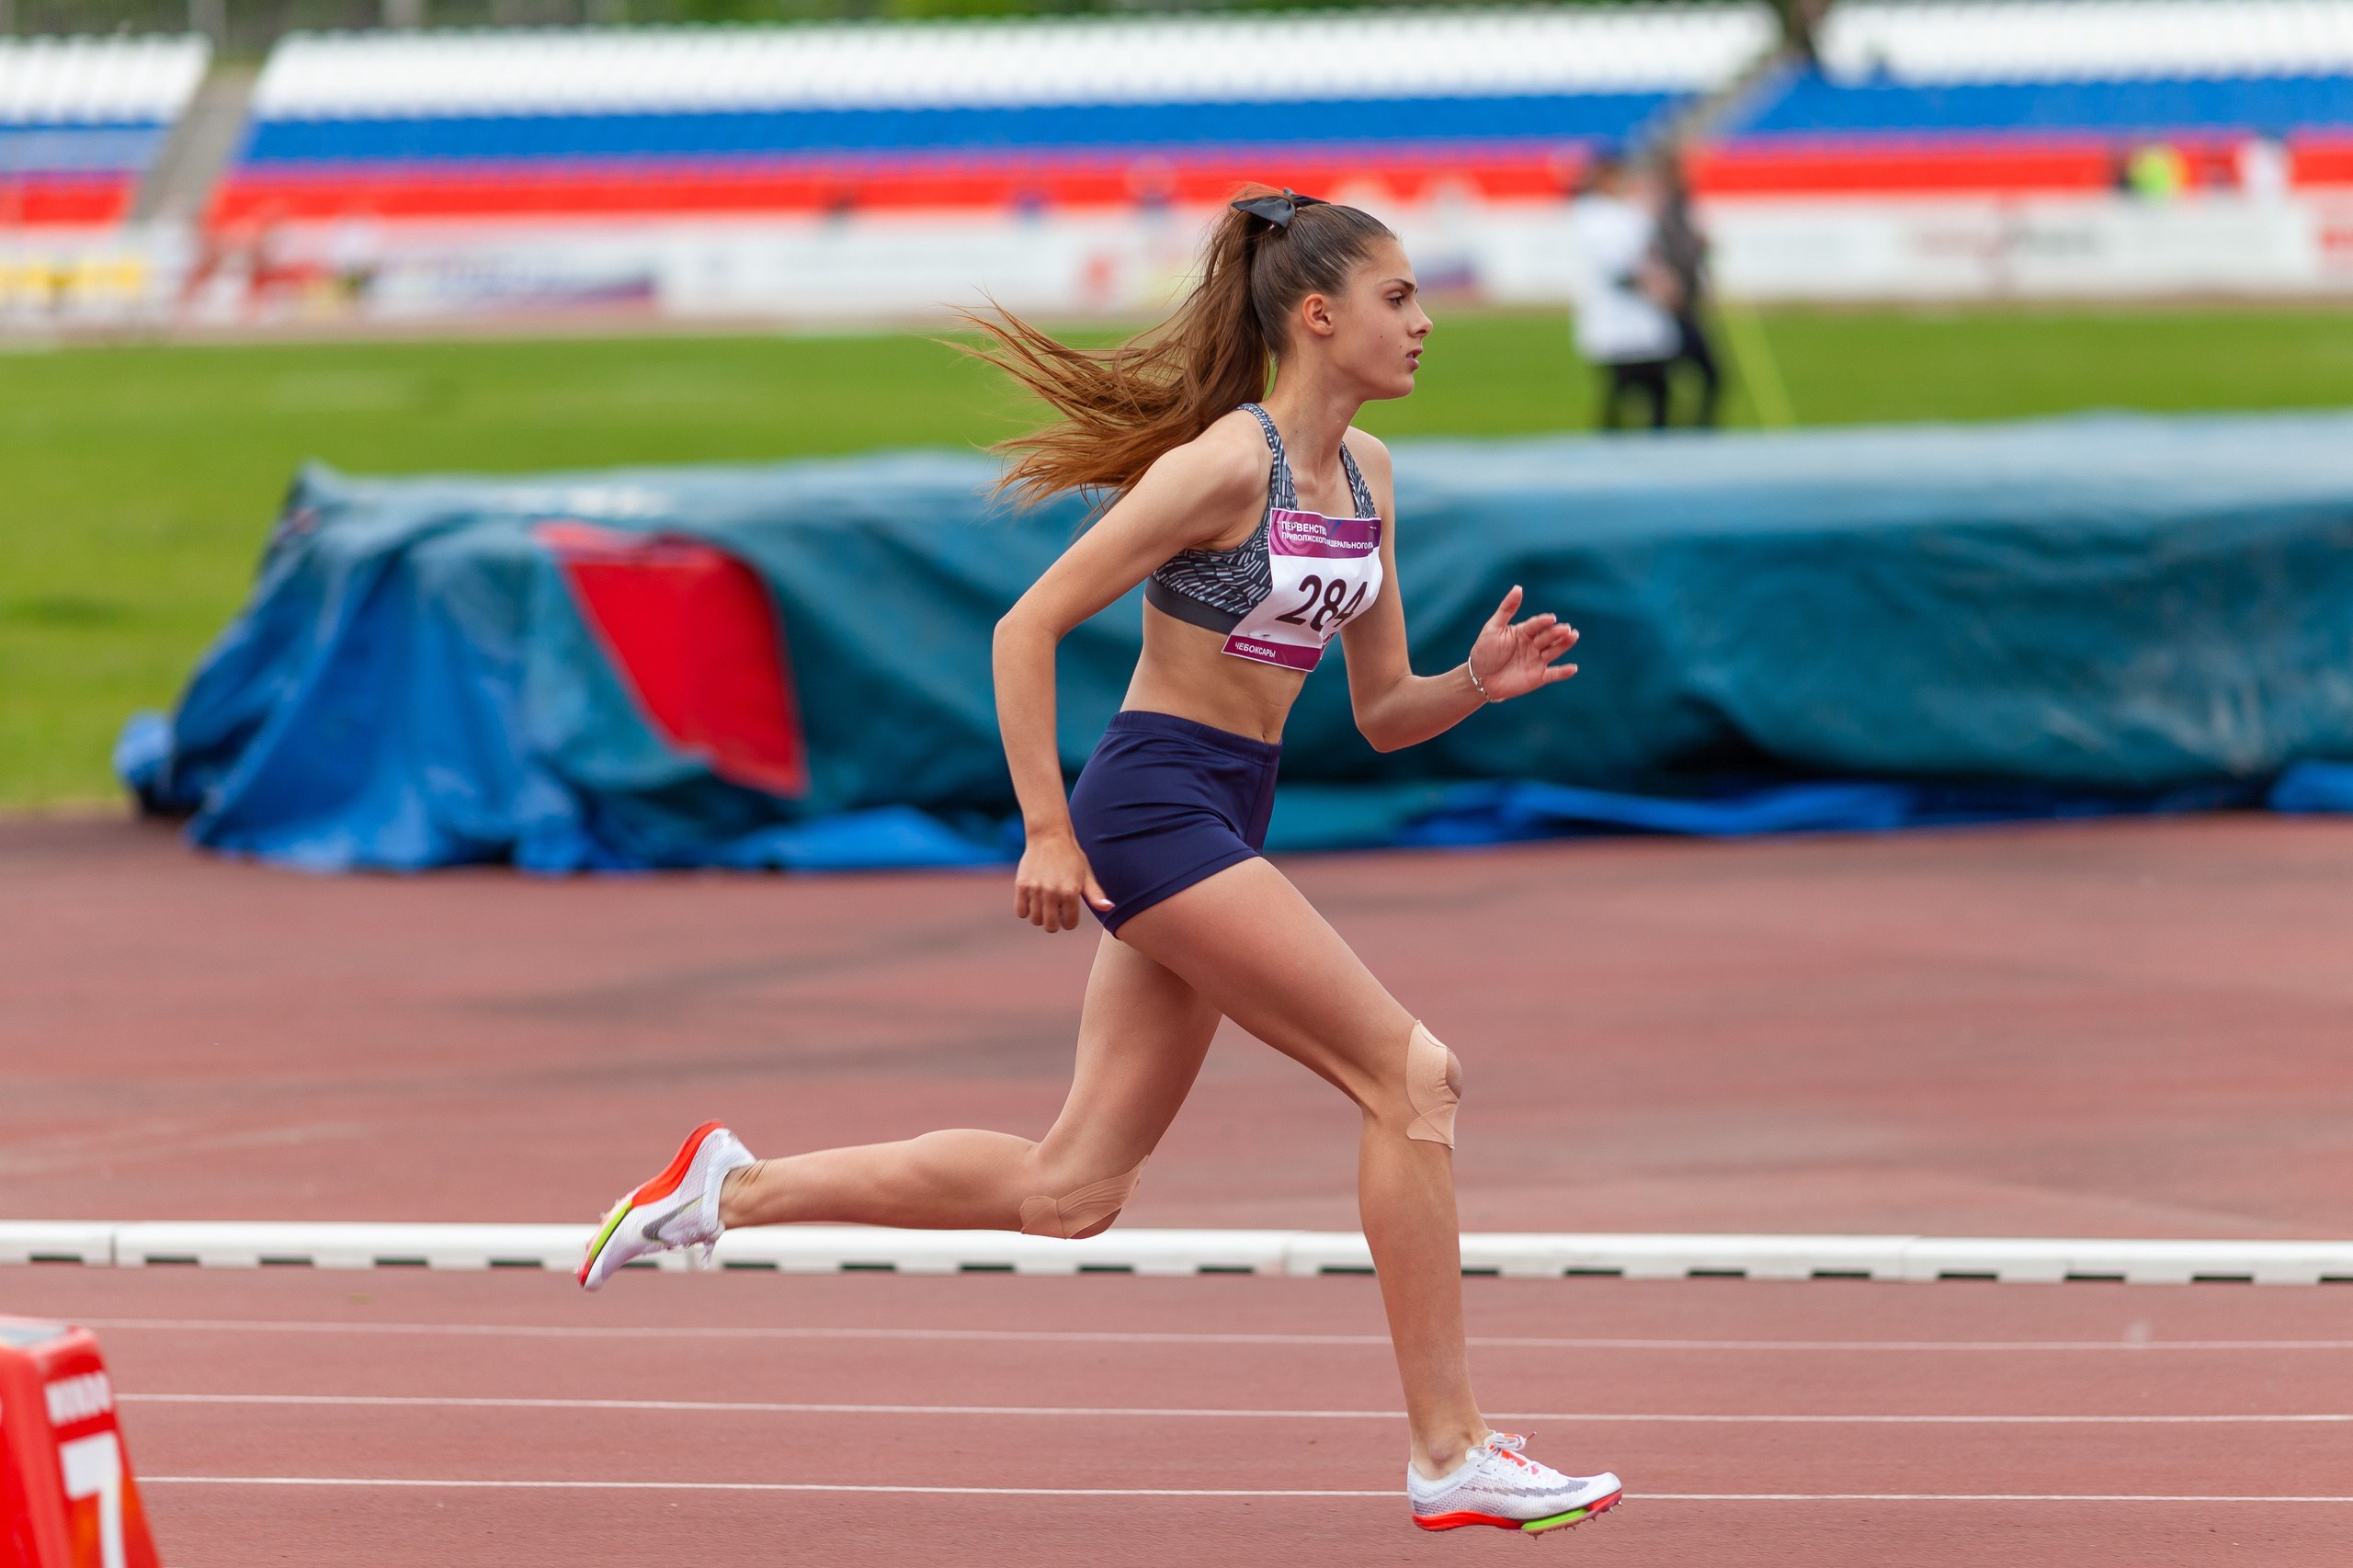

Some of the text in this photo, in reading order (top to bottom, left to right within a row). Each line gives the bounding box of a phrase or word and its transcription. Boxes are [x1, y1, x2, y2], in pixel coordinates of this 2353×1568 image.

[1275, 574, 1368, 631] 284
[1234, 642, 1276, 658] ЧЕБОКСАРЫ
[61, 1431, 127, 1568] 7
